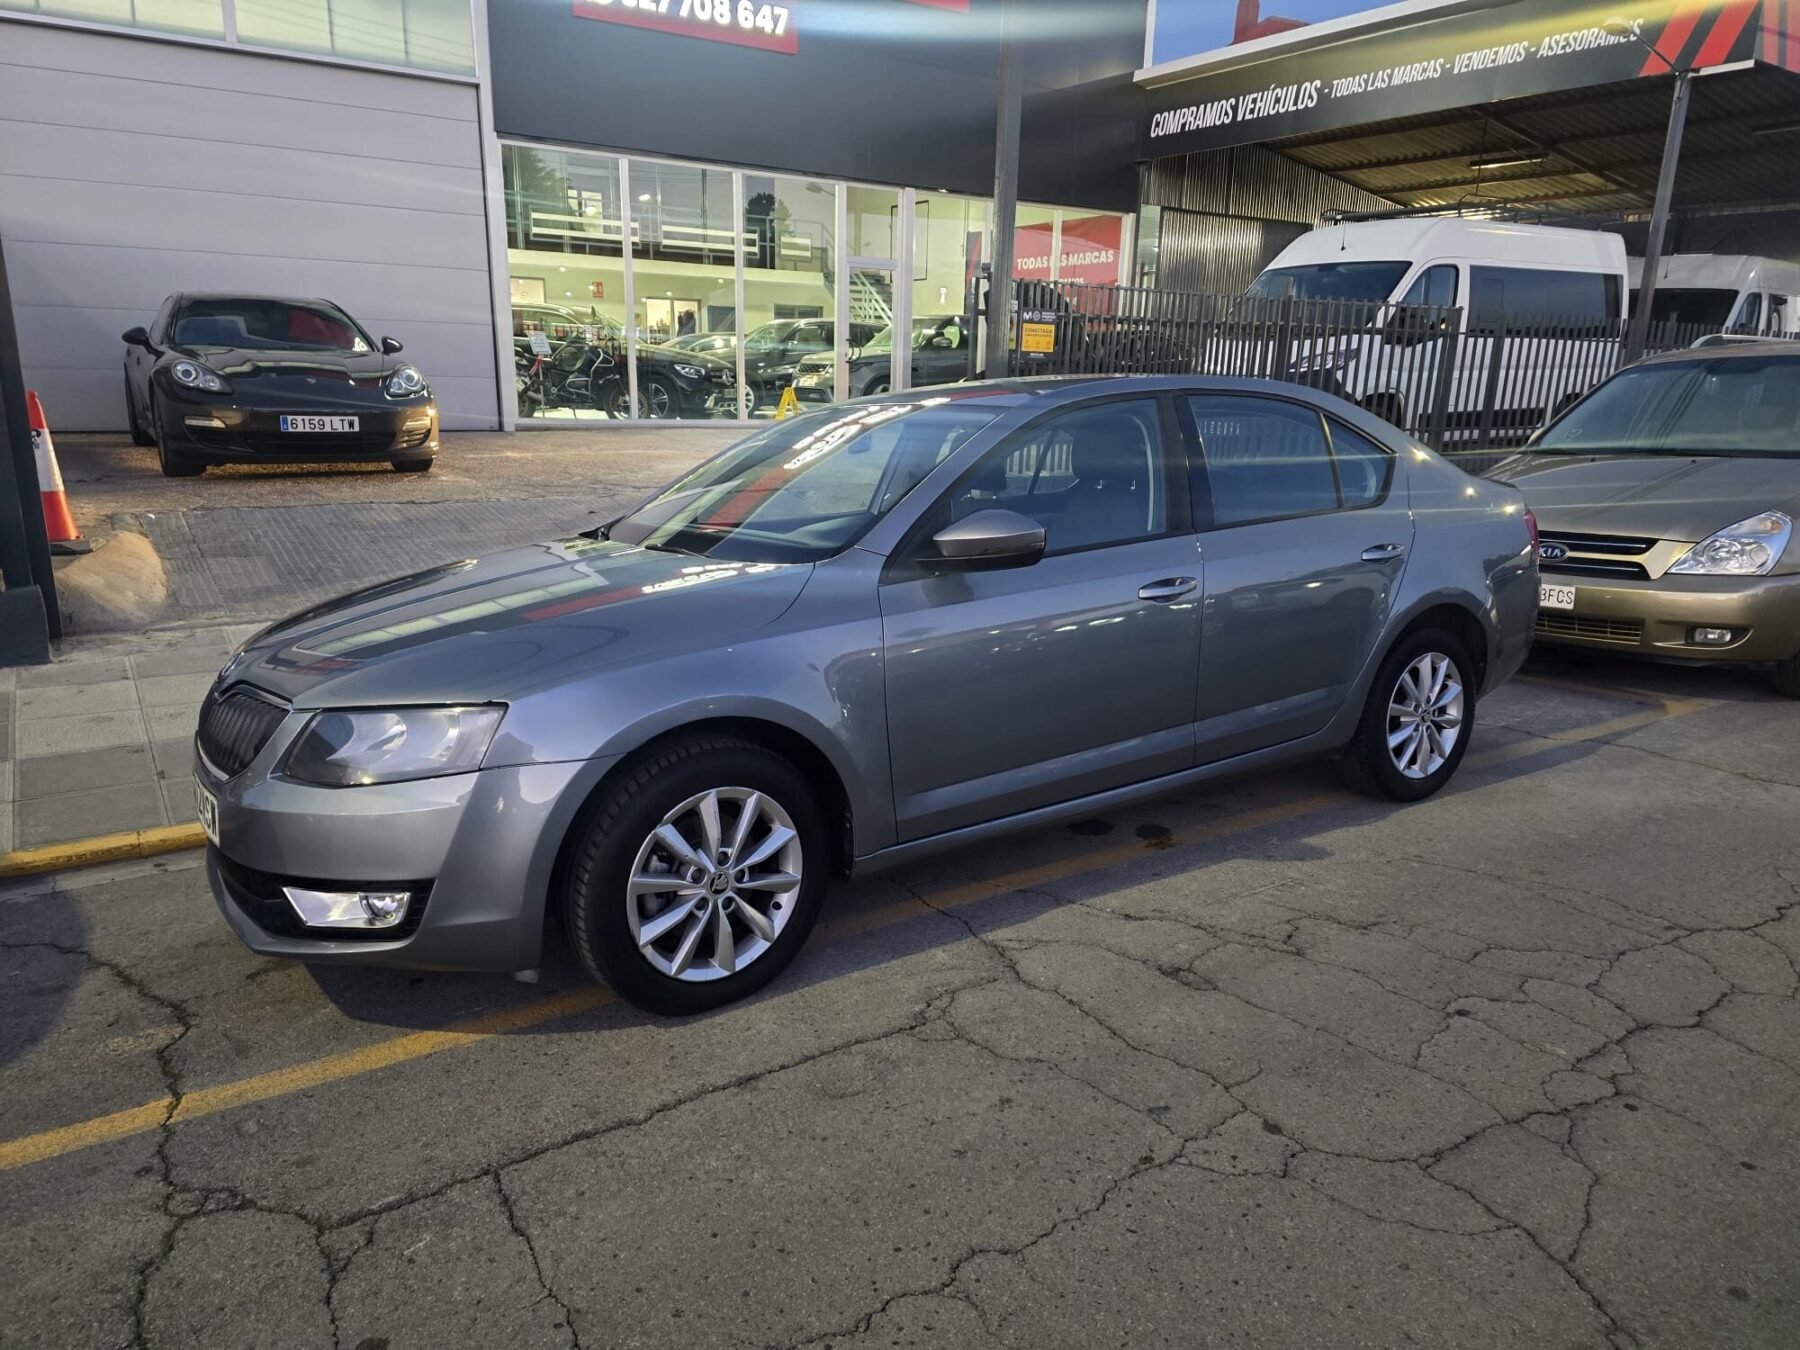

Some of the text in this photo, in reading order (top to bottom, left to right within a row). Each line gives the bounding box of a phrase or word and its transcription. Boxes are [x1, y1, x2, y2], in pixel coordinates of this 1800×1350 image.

[737, 3, 788, 35] 647
[1150, 98, 1235, 138] COMPRAMOS
[1236, 80, 1321, 122] VEHÍCULOS
[1331, 74, 1368, 99] TODAS
[1367, 69, 1391, 91] LAS
[1391, 58, 1444, 86] MARCAS
[1453, 41, 1529, 74] VENDEMOS
[1016, 256, 1048, 271] TODAS
[1068, 250, 1114, 266] MARCAS
[290, 418, 355, 431] 6159 LTW
[1539, 547, 1561, 558] KIA
